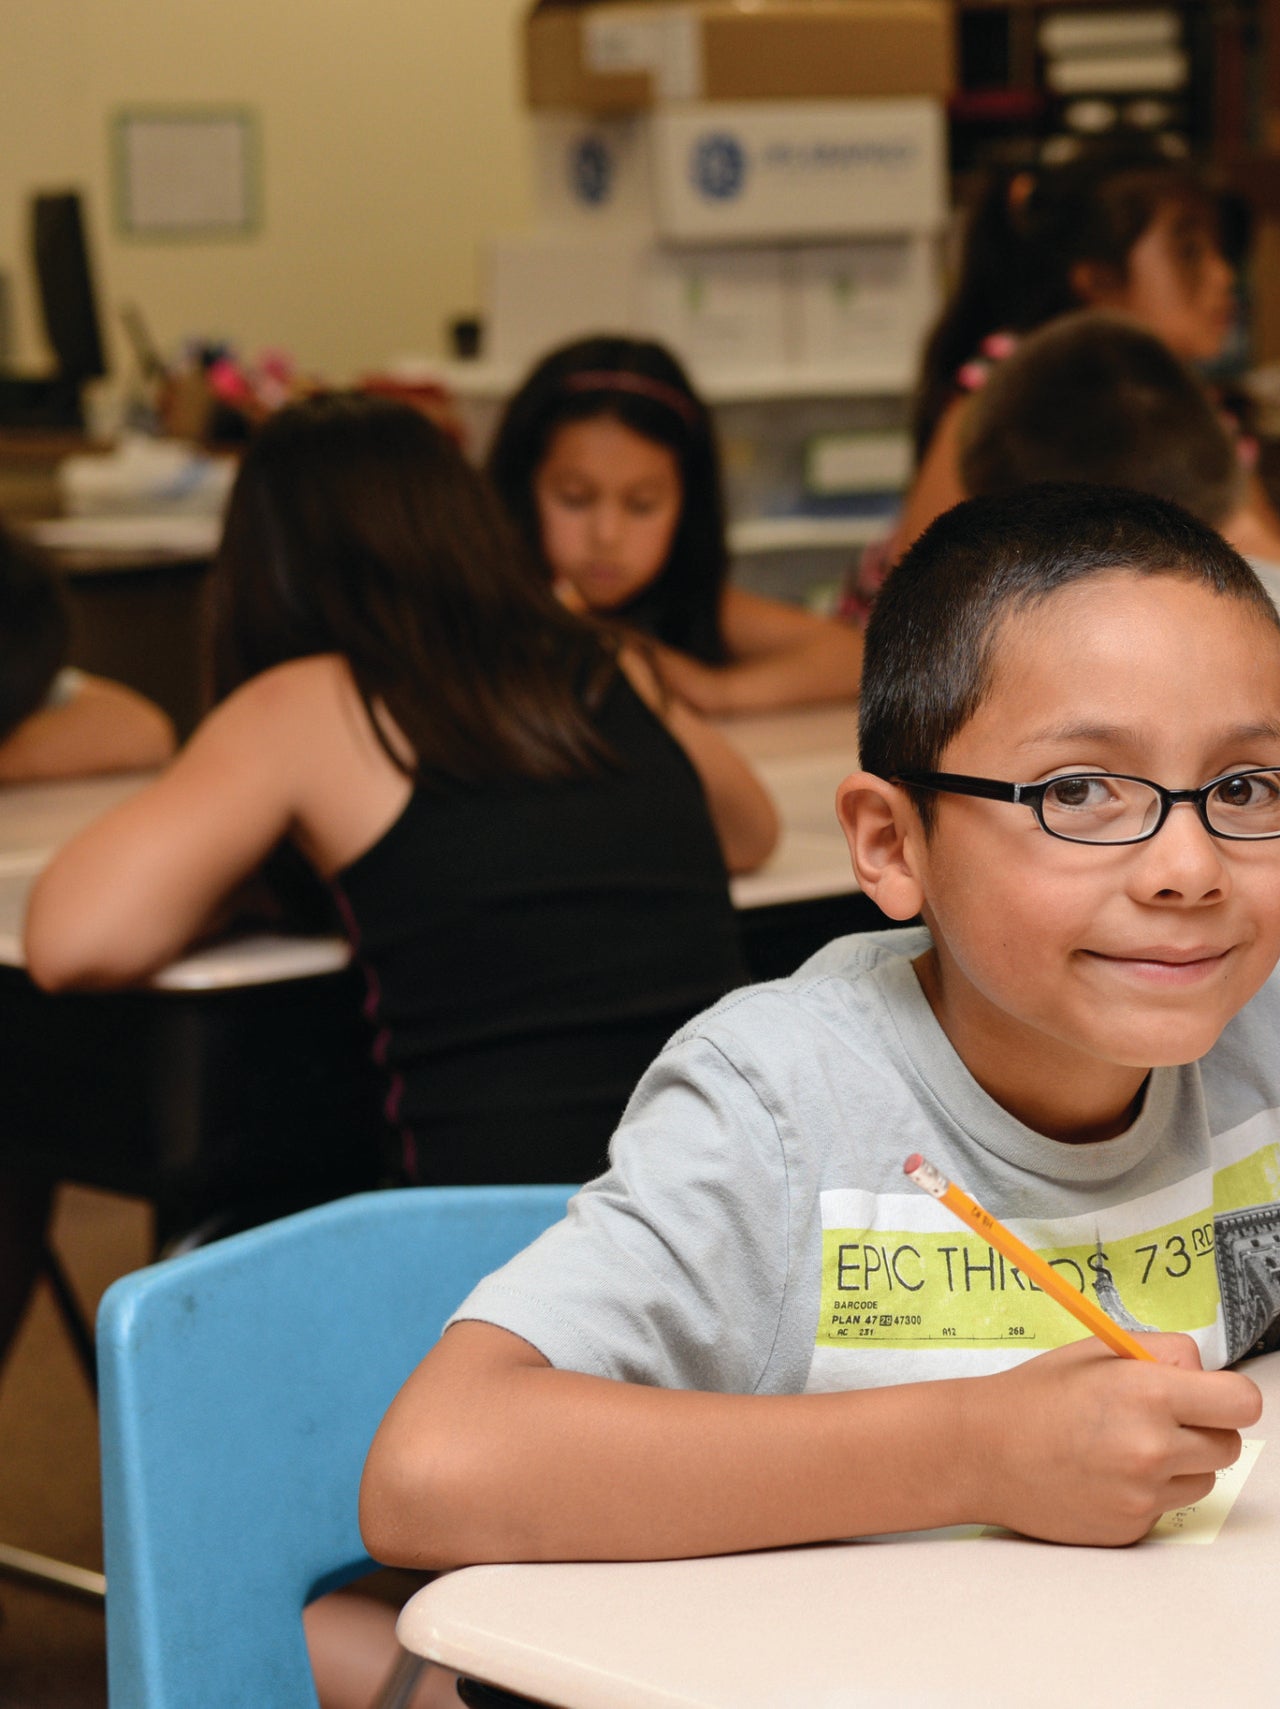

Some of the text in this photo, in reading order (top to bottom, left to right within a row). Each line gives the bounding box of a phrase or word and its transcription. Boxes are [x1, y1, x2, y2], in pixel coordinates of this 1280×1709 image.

[838, 1244, 925, 1292] EPIC
[834, 1301, 878, 1310] BARCODE
[831, 1315, 861, 1325] PLAN
